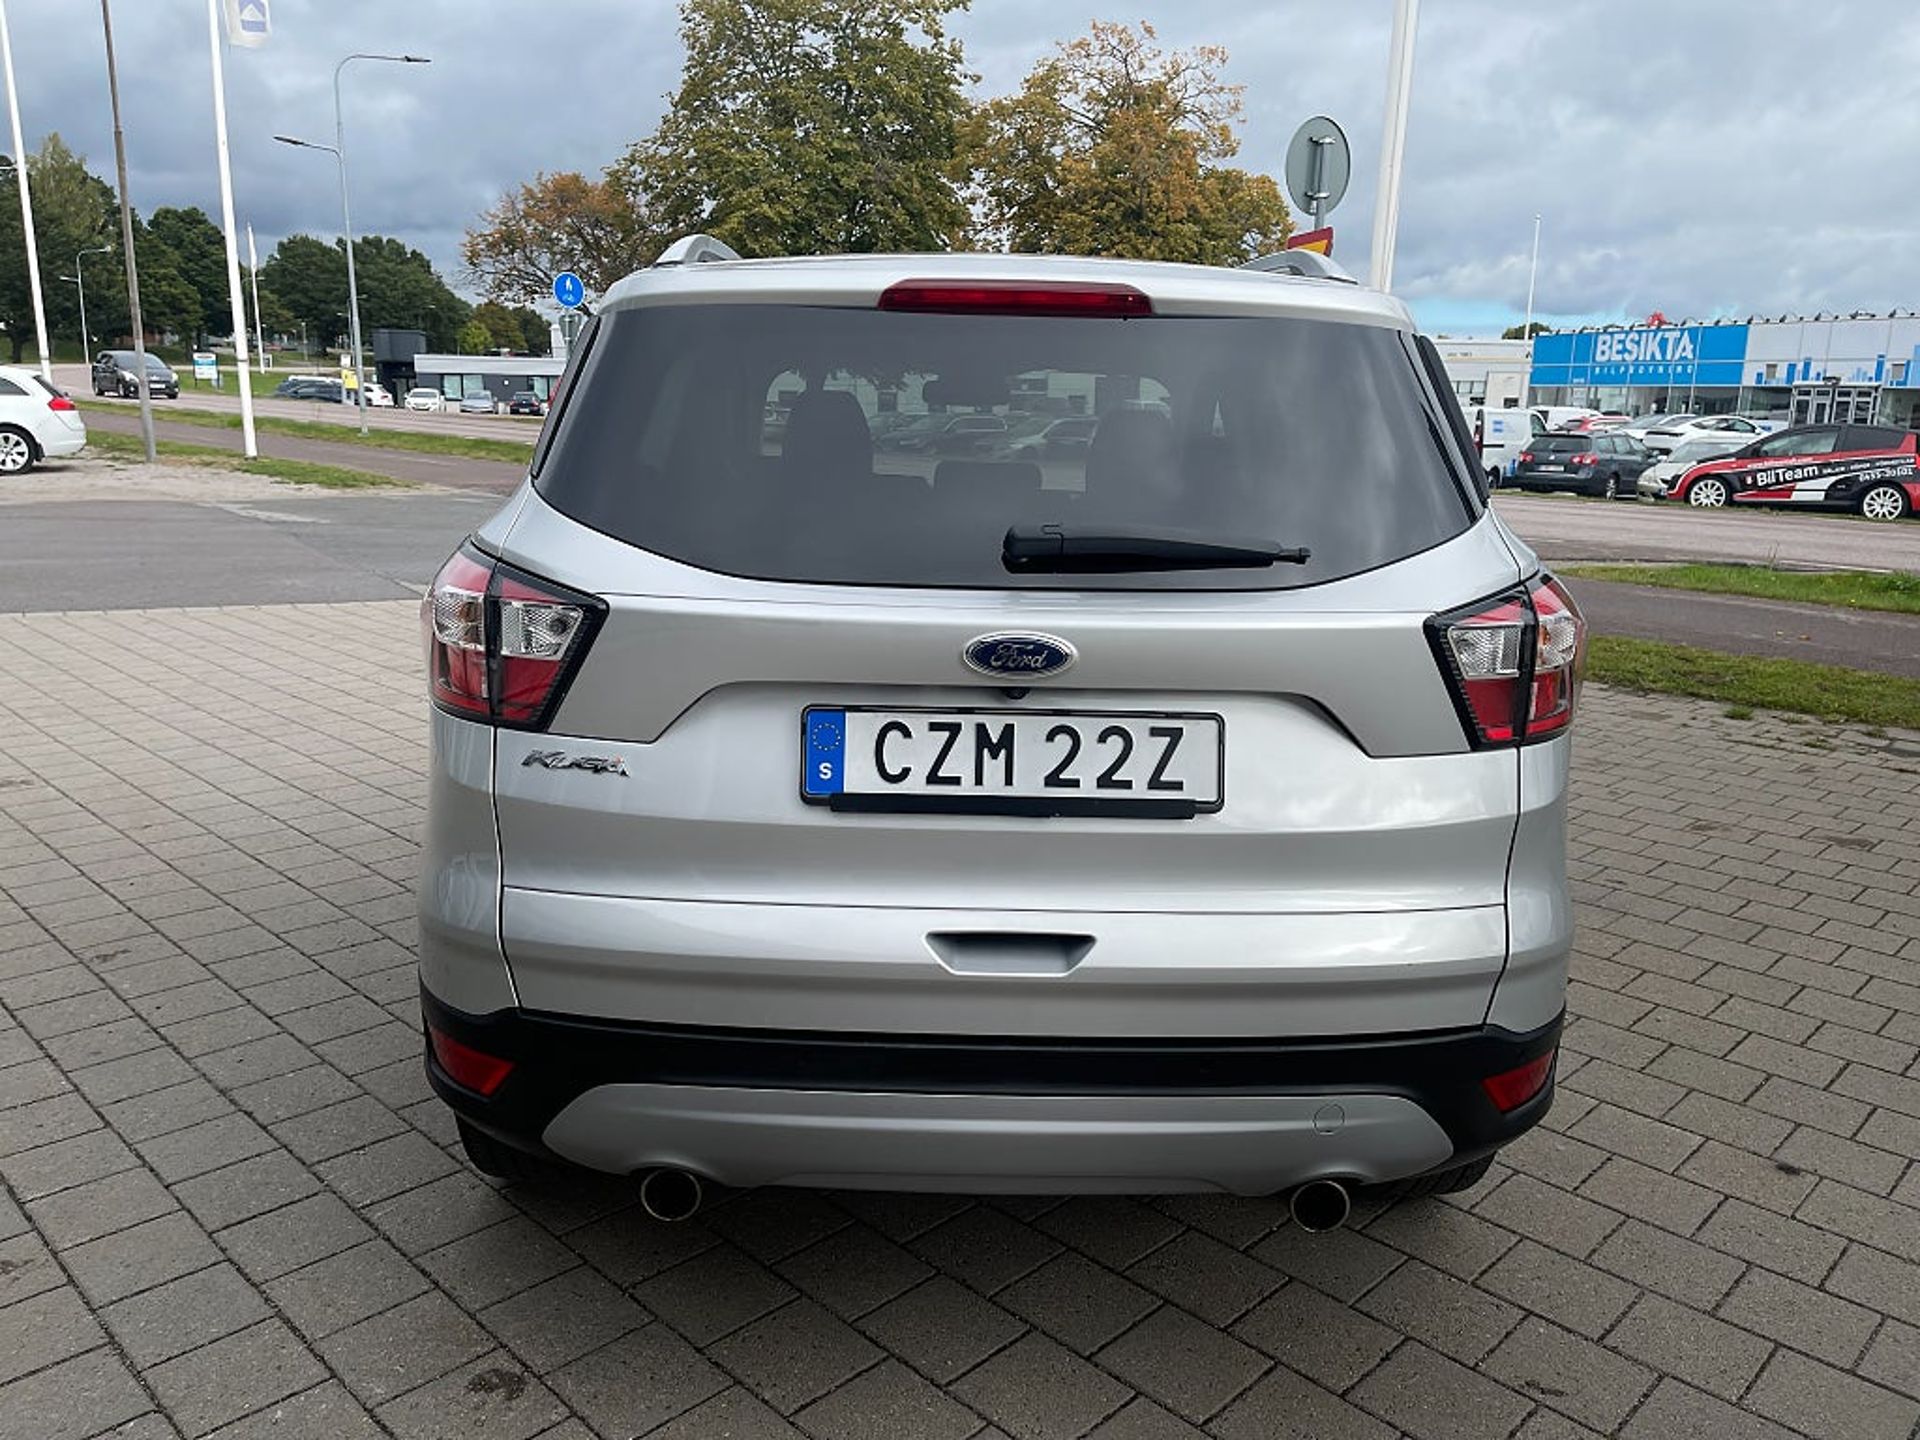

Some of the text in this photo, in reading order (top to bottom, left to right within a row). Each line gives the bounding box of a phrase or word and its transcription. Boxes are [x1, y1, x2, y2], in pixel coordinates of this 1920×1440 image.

[1595, 330, 1694, 362] BESIKTA
[1756, 466, 1818, 487] BilTeam
[989, 642, 1049, 669] Ford
[874, 720, 1184, 791] CZM 22Z
[818, 762, 833, 780] S
